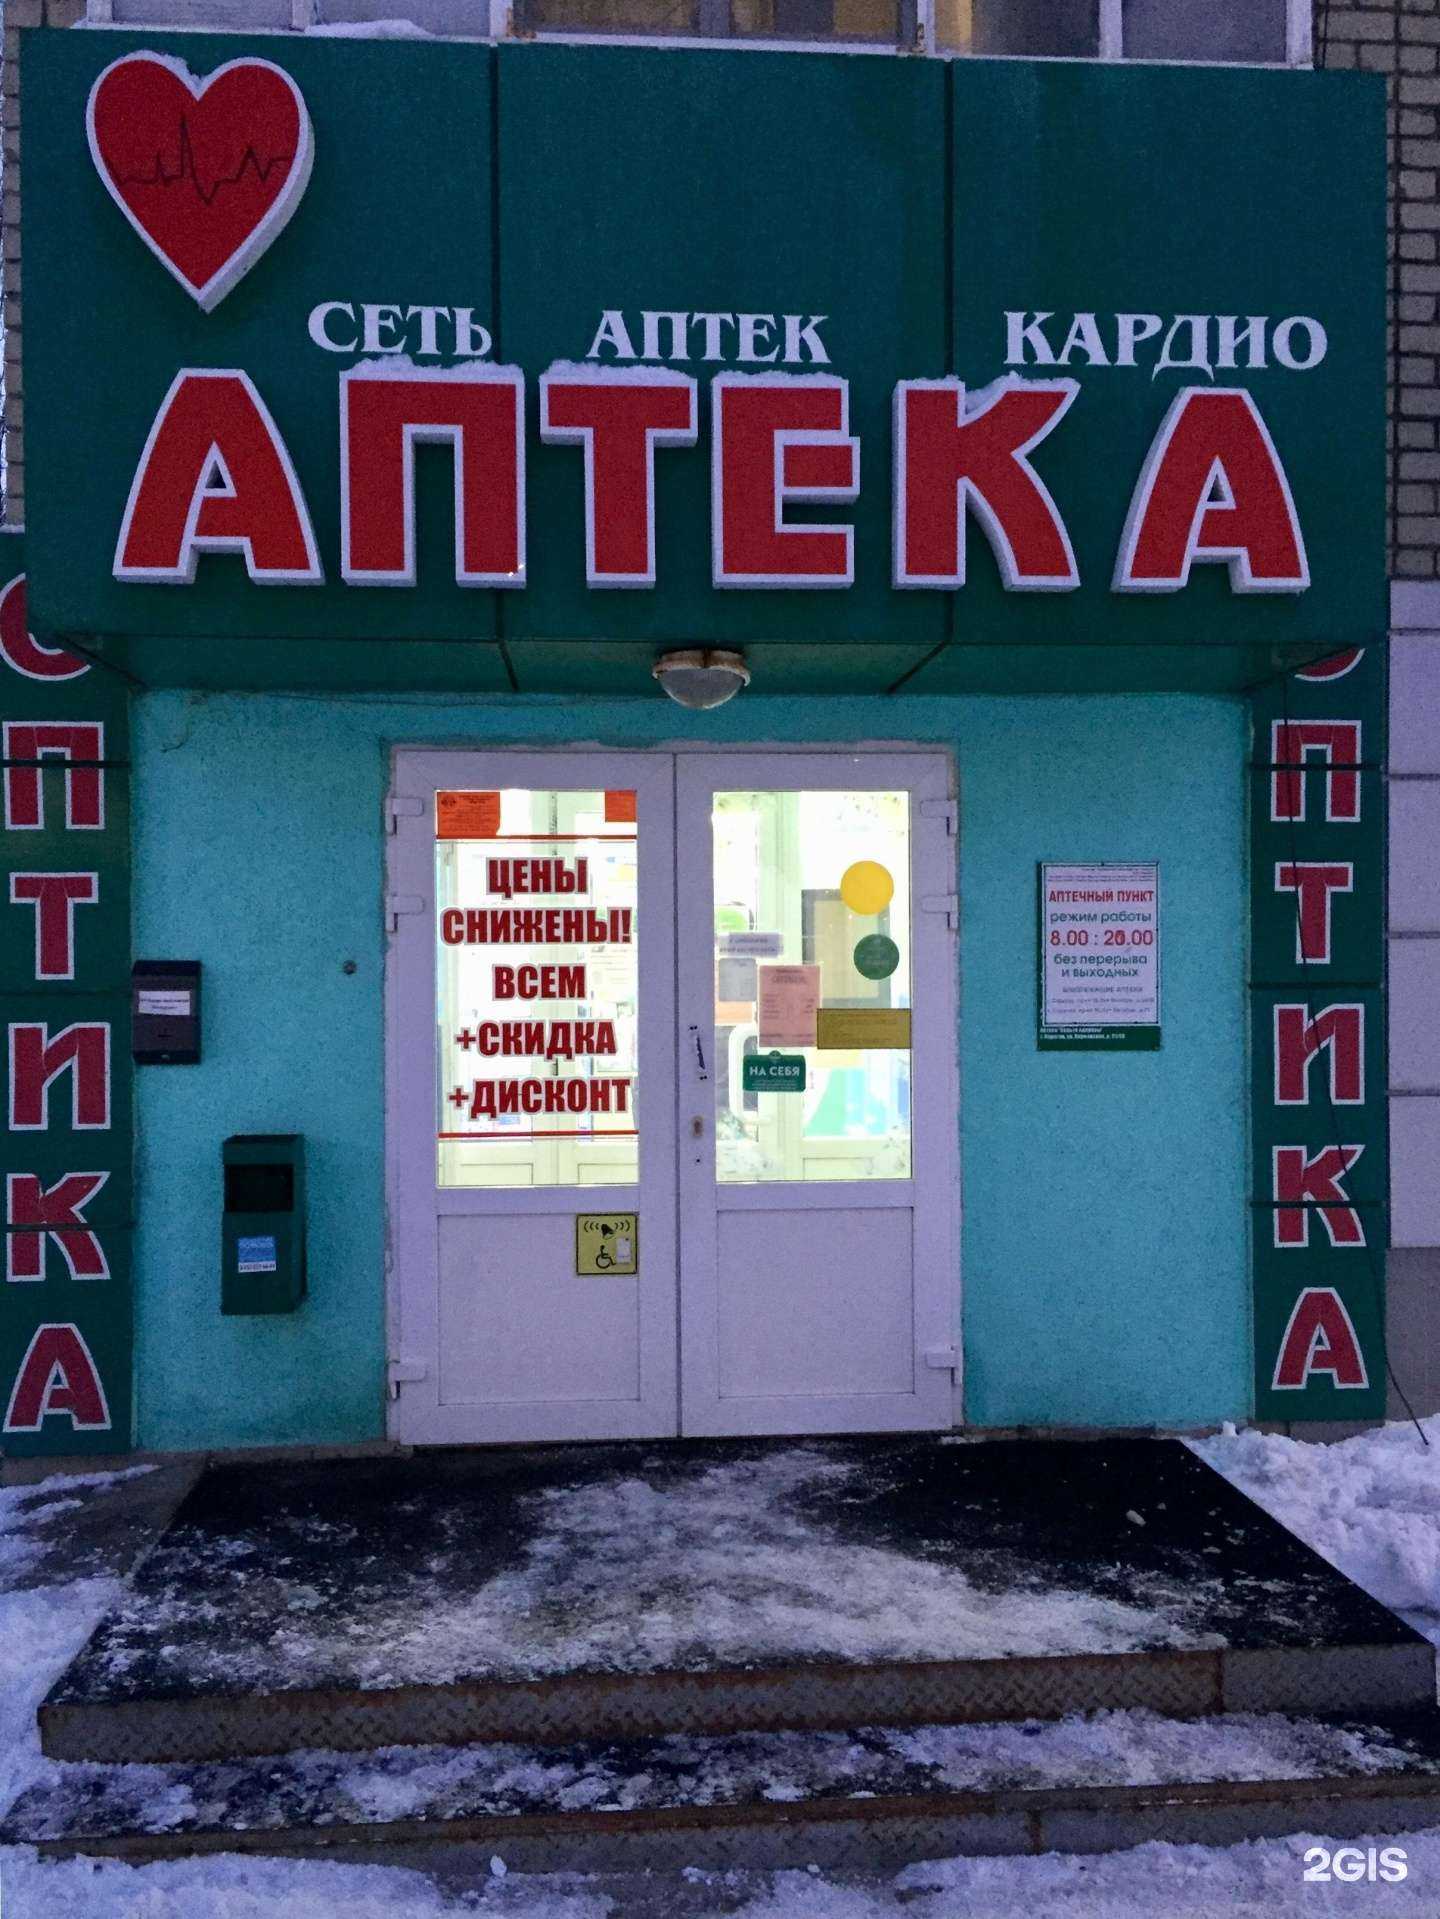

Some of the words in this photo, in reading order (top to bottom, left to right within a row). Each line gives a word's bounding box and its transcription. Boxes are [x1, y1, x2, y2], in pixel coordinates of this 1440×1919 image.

[307, 301, 493, 357] СЕТЬ
[584, 309, 833, 363] АПТЕК
[1003, 310, 1328, 381] КАРДИО
[113, 367, 1311, 594] АПТЕКА
[486, 857, 589, 899] ЦЕНЫ
[1049, 888, 1113, 902] АПТЕЧНЫЙ
[1117, 890, 1154, 902] ПУНКТ
[440, 907, 633, 945] СНИЖЕНЫ!
[1050, 912, 1097, 924] режим
[1101, 911, 1151, 924] работы
[1050, 930, 1088, 945] 8.00
[1054, 954, 1077, 965] без
[1080, 955, 1147, 966] перерыва
[1073, 968, 1139, 979] выходных
[492, 963, 587, 1000] ВСЕМ
[1271, 648, 1370, 1390] ПТИКА
[455, 1018, 619, 1061] +СКИДКА
[749, 1066, 767, 1076] НА
[769, 1066, 800, 1077] СЕБЯ
[448, 1077, 632, 1121] +ДИСКОНТ
